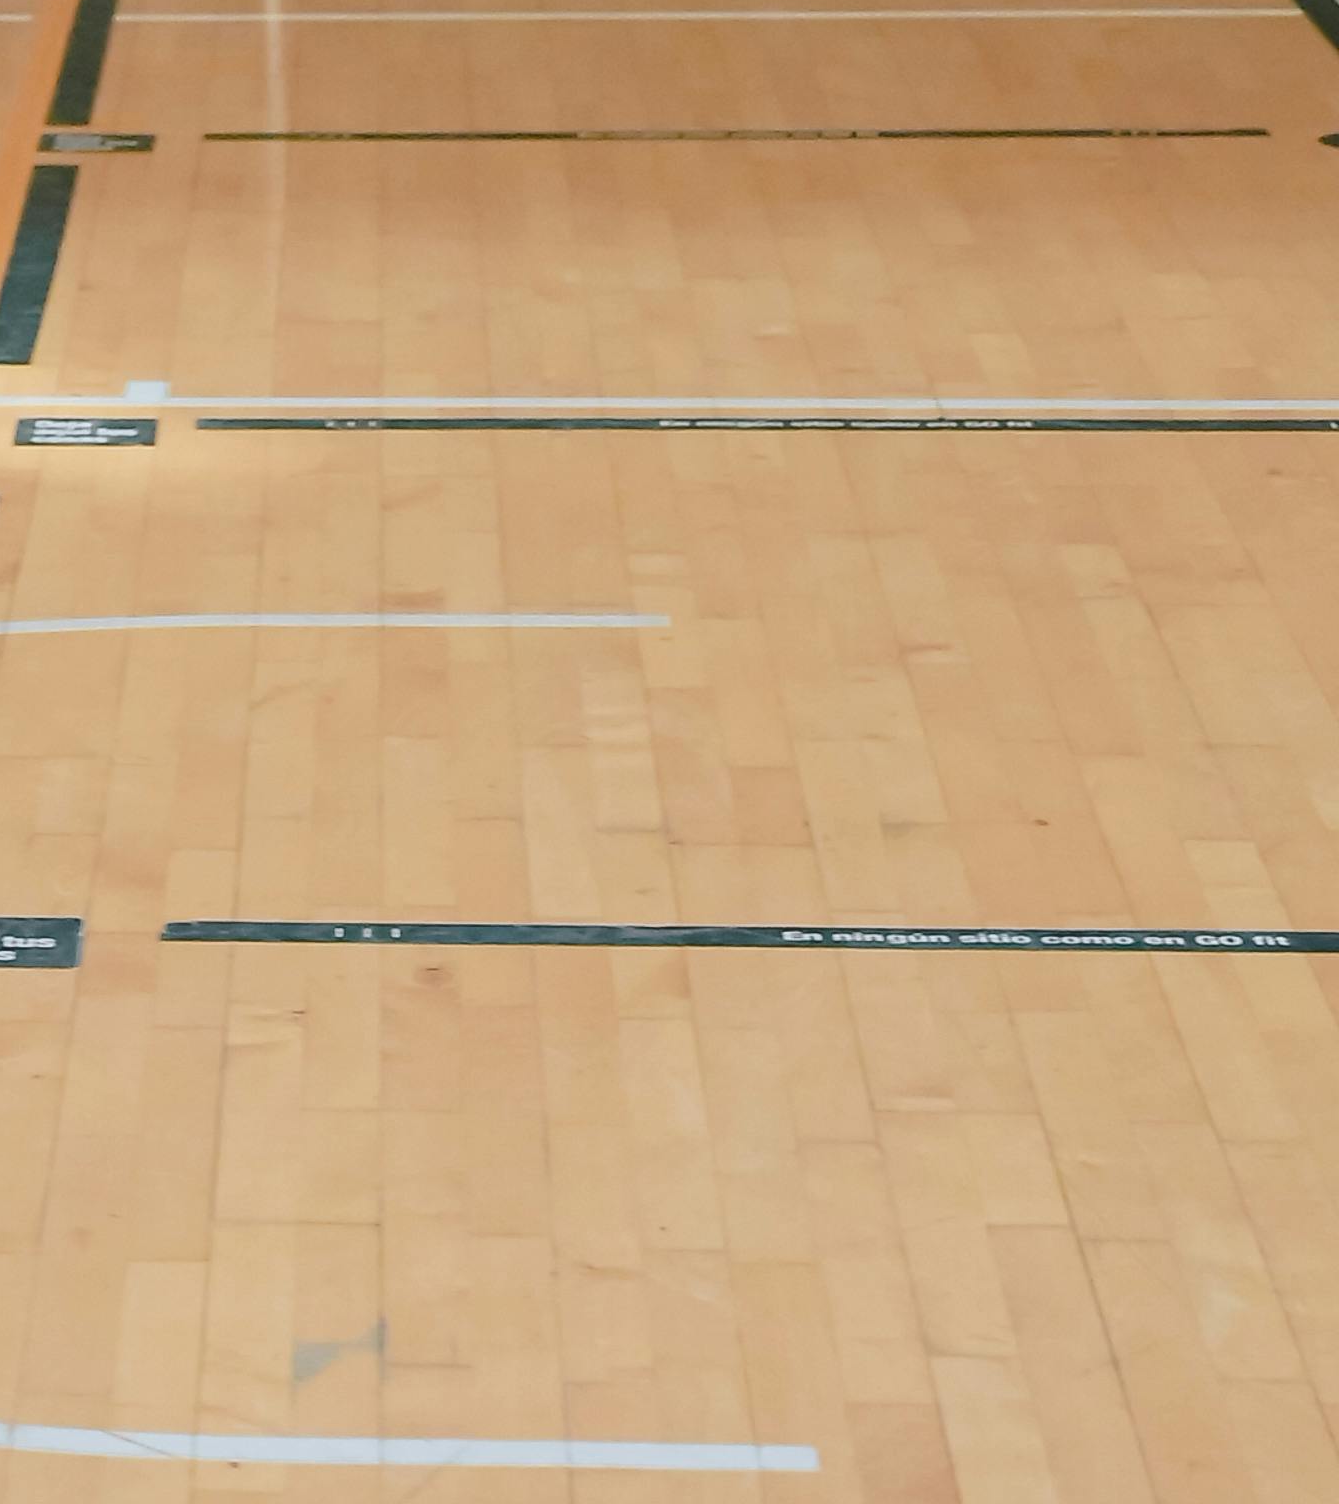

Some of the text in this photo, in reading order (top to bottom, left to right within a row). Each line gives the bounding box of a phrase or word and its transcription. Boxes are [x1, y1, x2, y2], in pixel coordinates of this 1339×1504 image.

[2, 936, 56, 948] tus
[781, 930, 824, 942] En
[958, 932, 1032, 945] sitio
[1041, 934, 1135, 946] como
[1143, 934, 1186, 946] en
[1194, 934, 1243, 946] GO
[1251, 934, 1291, 947] fit
